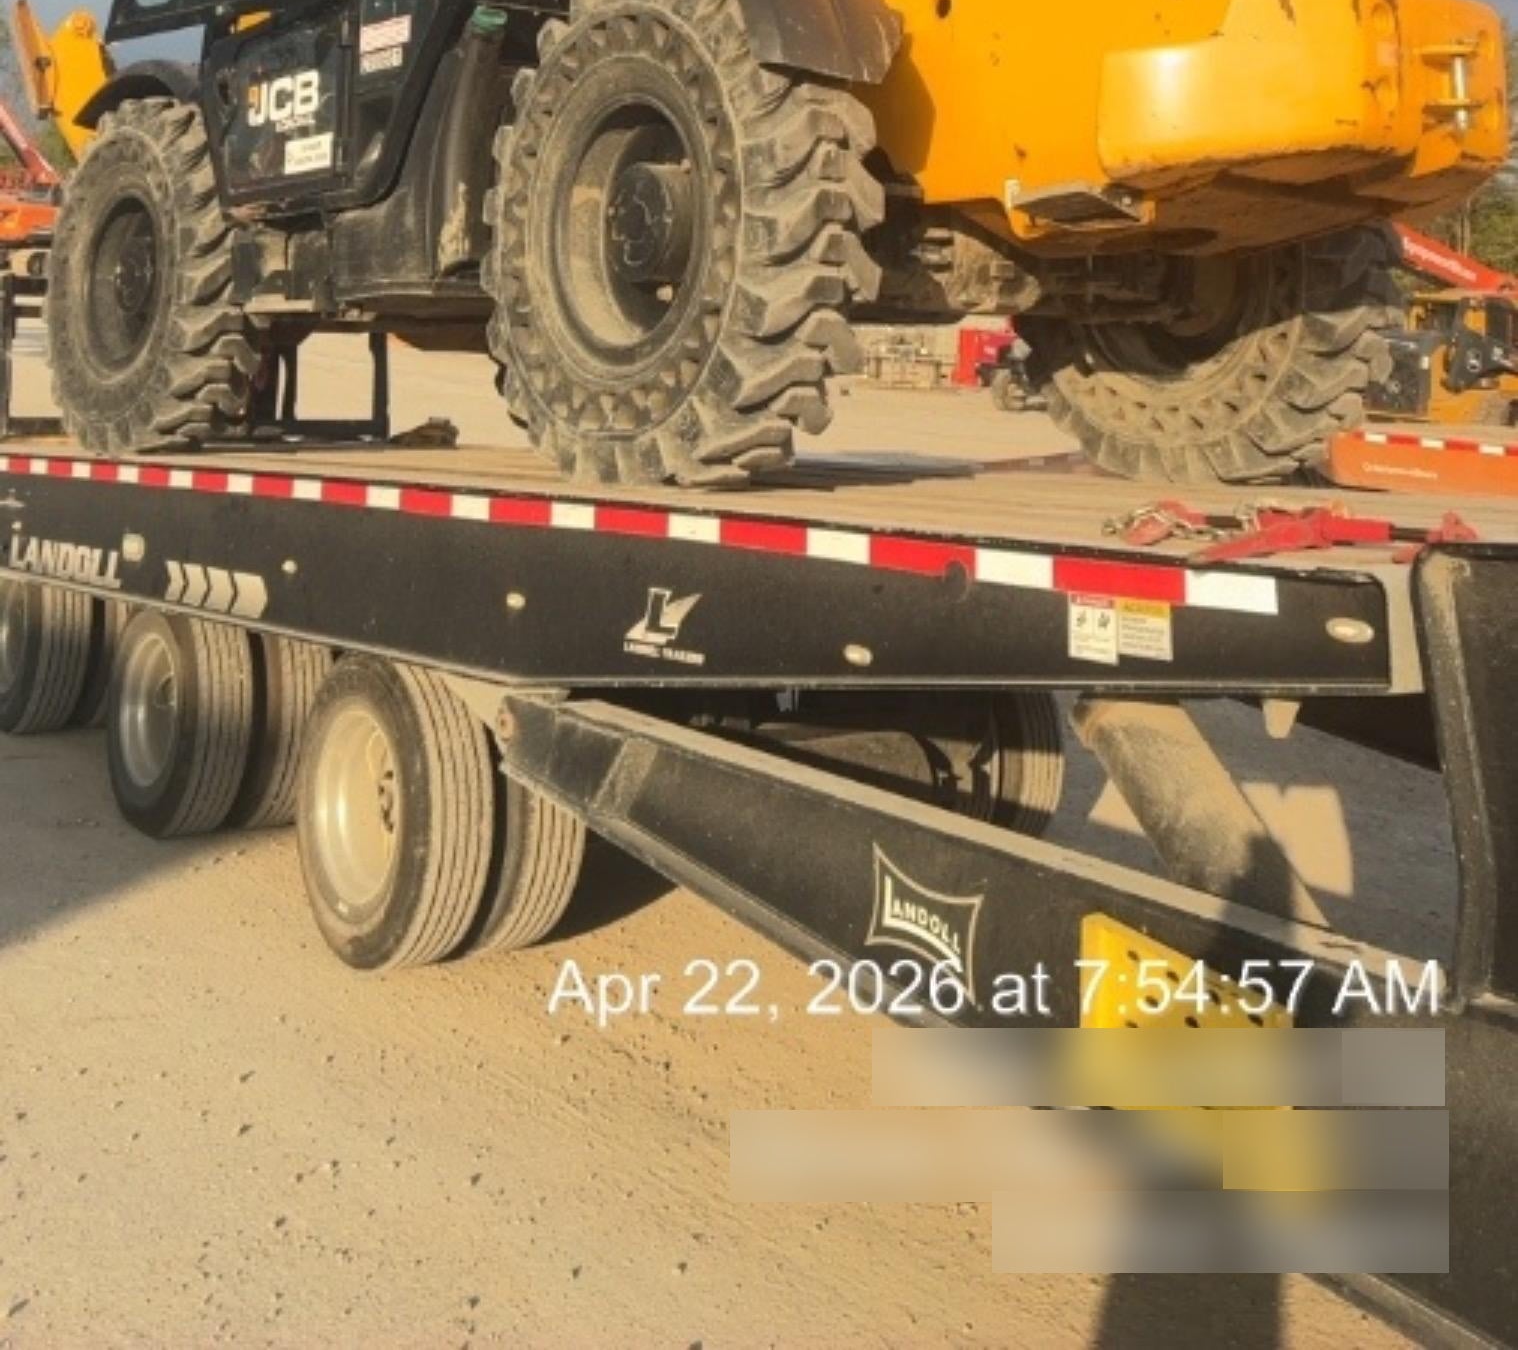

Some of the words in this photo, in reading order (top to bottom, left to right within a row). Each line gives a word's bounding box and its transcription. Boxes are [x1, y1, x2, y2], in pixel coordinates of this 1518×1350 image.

[248, 69, 320, 127] JCB
[9, 534, 121, 588] LANDOLL
[882, 875, 962, 973] LANDOLL
